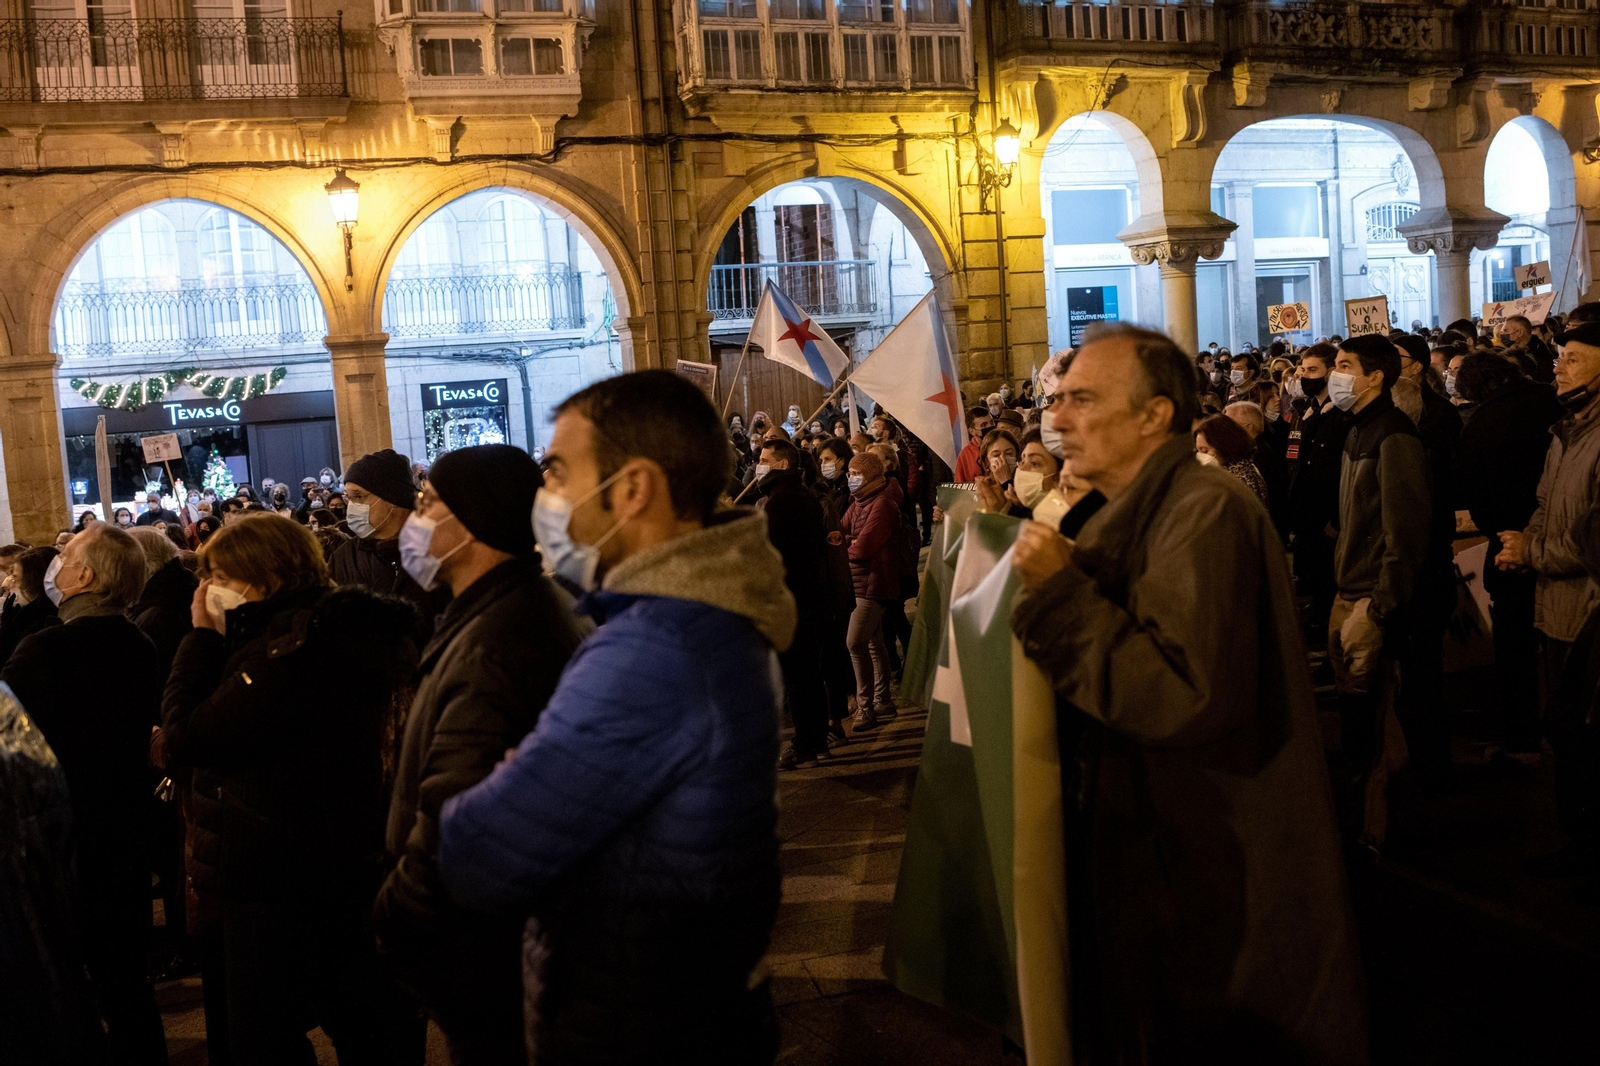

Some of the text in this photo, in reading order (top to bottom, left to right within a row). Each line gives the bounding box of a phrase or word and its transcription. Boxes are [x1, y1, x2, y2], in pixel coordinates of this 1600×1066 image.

[1521, 276, 1546, 288] erguer
[1351, 305, 1378, 316] VIVA
[1363, 314, 1371, 324] O
